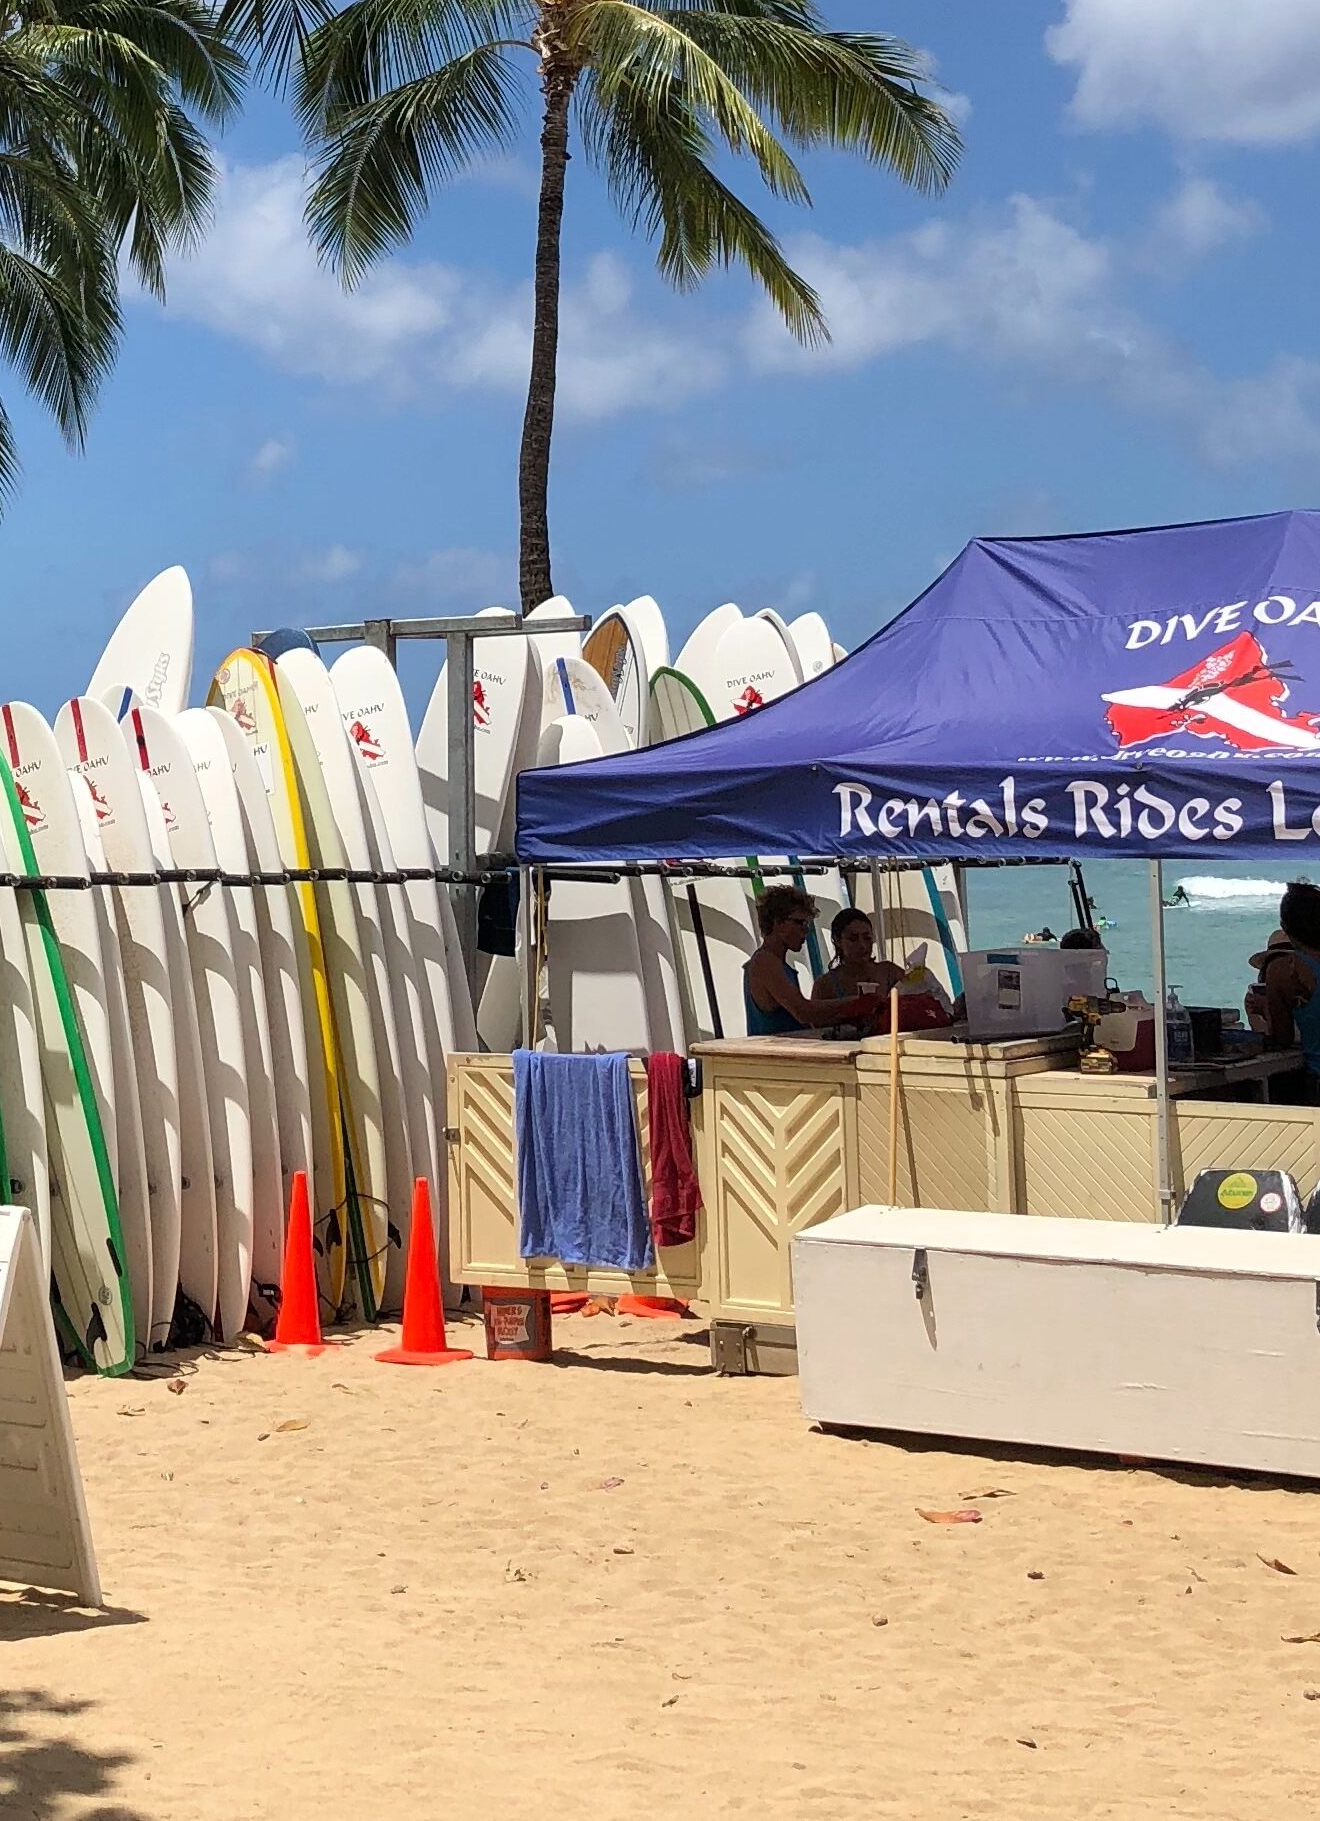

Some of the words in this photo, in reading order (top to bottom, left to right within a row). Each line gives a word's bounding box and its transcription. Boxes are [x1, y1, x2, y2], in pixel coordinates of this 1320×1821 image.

[1125, 600, 1249, 650] DIVE
[481, 671, 507, 686] OAHU
[726, 676, 748, 688] DIVE
[749, 670, 776, 683] OAHU
[304, 703, 319, 715] HU
[357, 702, 385, 718] OAHU
[253, 745, 269, 756] HU
[15, 759, 42, 778] OAHU
[83, 755, 110, 772] OAHU
[832, 776, 1049, 839] Rentals
[1065, 779, 1244, 840] Rides
